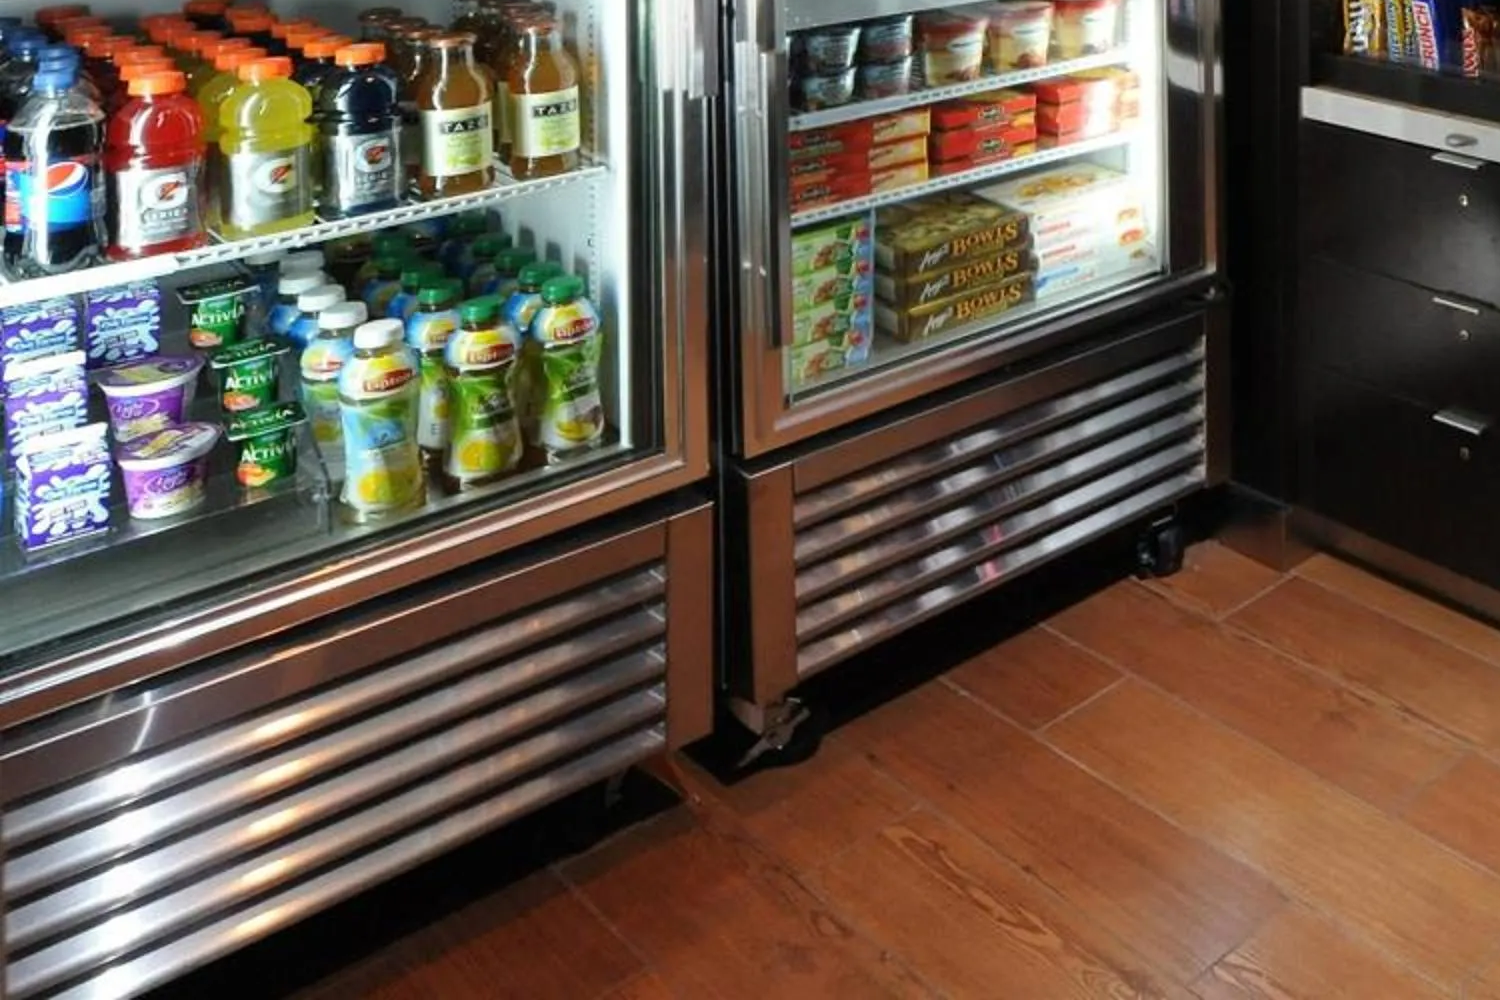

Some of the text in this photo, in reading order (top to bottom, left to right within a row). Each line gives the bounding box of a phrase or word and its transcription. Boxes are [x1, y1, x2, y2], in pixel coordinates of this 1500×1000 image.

[952, 222, 1018, 257] BOWLS
[952, 250, 1019, 288] BOWLS
[956, 281, 1022, 319] BOWLS
